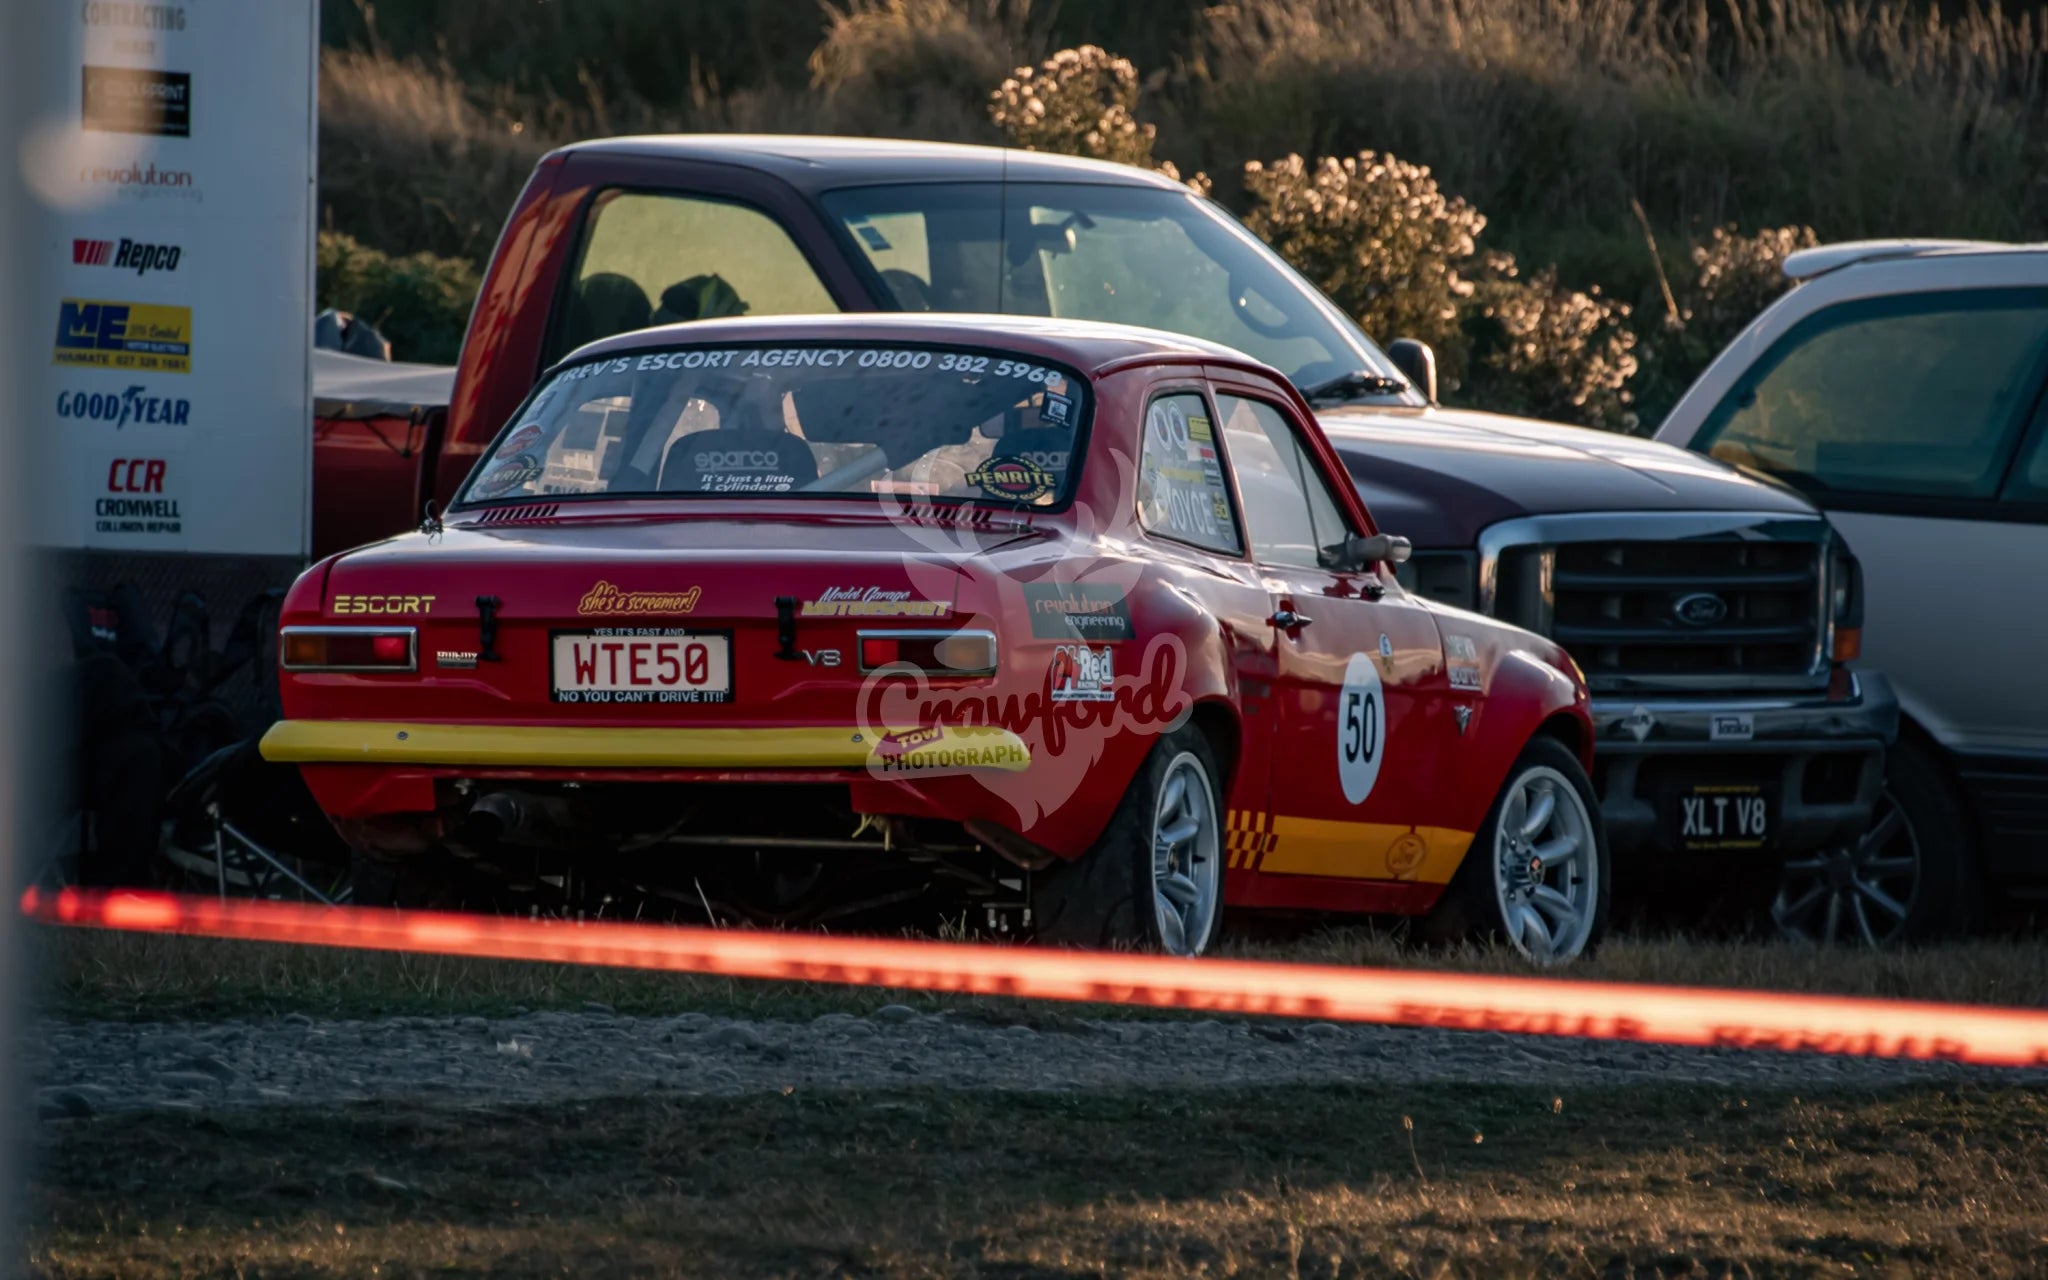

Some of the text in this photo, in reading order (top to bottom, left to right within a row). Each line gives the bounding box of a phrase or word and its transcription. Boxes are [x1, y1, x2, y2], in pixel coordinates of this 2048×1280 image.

[81, 1, 187, 31] CONTRACTING
[80, 161, 192, 186] revolution
[114, 238, 181, 276] Repco
[56, 302, 130, 349] ME
[636, 351, 739, 371] ESCORT
[741, 349, 854, 367] AGENCY
[858, 350, 932, 369] 0800
[938, 354, 990, 373] 382
[994, 360, 1062, 387] 5968
[57, 387, 190, 428] GOODYEAR
[694, 450, 779, 472] sparco
[108, 458, 166, 493] CCR
[701, 474, 723, 483] It's
[726, 474, 752, 485] just
[765, 474, 794, 483] little
[966, 471, 1056, 488] PENRITE
[701, 483, 711, 491] 4
[715, 482, 775, 492] cylinder
[96, 498, 181, 518] CROMWELL
[334, 595, 436, 614] ESCORT
[627, 586, 700, 611] screamer!
[819, 586, 911, 602] Model Garage
[1035, 593, 1115, 614] revolution
[801, 601, 952, 616] MOTORSPORT
[594, 628, 685, 636] YES IT'S FAST AND
[1065, 615, 1125, 630] engineering
[573, 643, 709, 685] WTE50
[802, 650, 842, 667] V8
[1079, 648, 1111, 681] Red
[558, 692, 725, 703] NO YOU CAN'T DRIVE IT!!
[896, 727, 939, 748] TOW
[1345, 691, 1377, 763] 50
[1682, 797, 1767, 836] XLT V8
